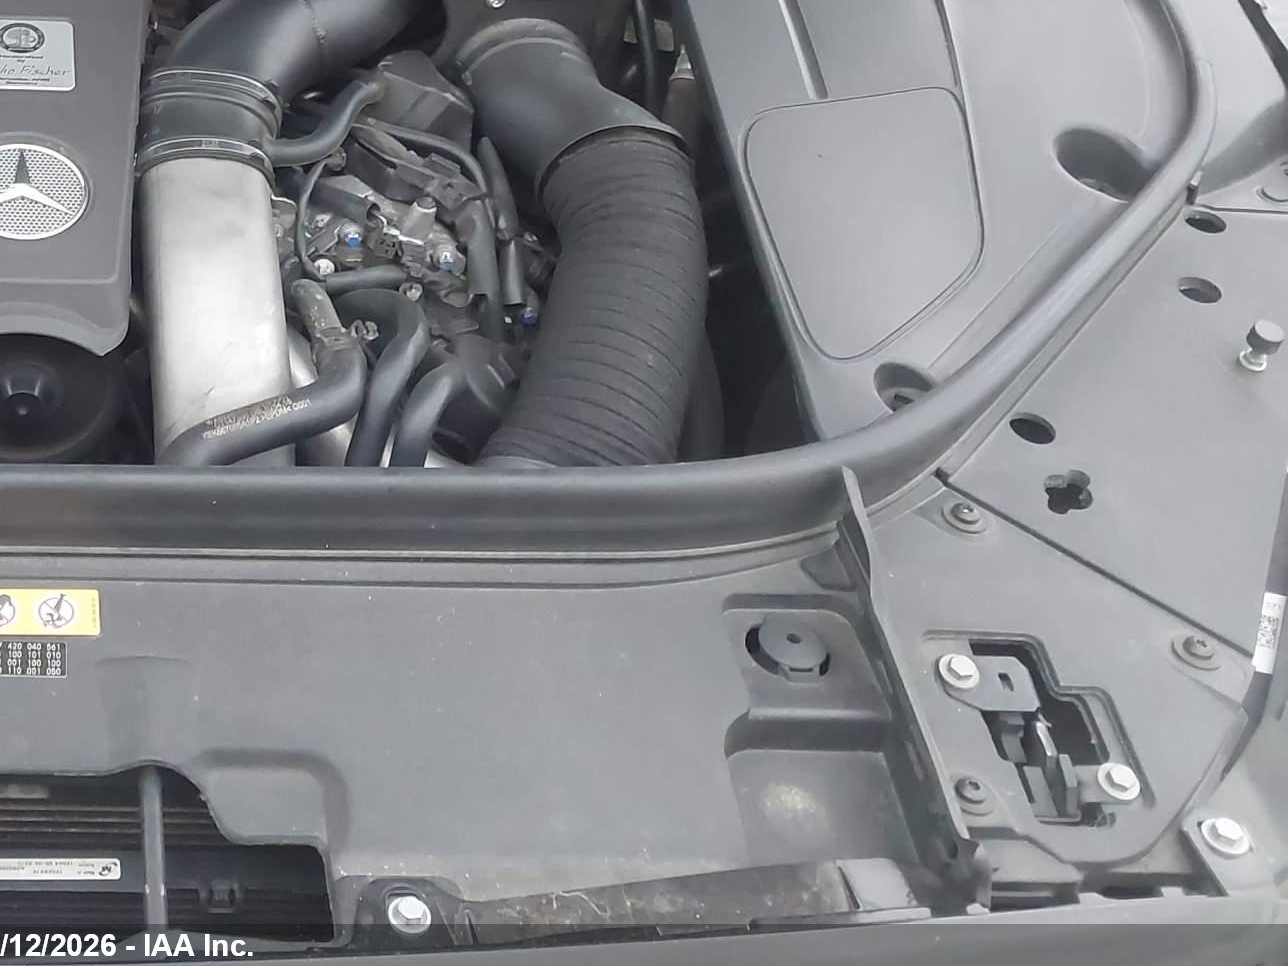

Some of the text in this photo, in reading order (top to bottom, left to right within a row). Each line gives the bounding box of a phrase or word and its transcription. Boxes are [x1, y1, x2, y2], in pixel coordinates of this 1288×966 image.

[20, 65, 72, 76] Fischer
[27, 642, 42, 651] 040
[9, 650, 22, 659] 100
[28, 651, 41, 659] 101
[46, 651, 61, 659] 010
[7, 658, 21, 667] 001
[28, 659, 42, 667] 100
[47, 659, 62, 668] 100
[8, 666, 22, 675] 110
[26, 667, 41, 675] 001
